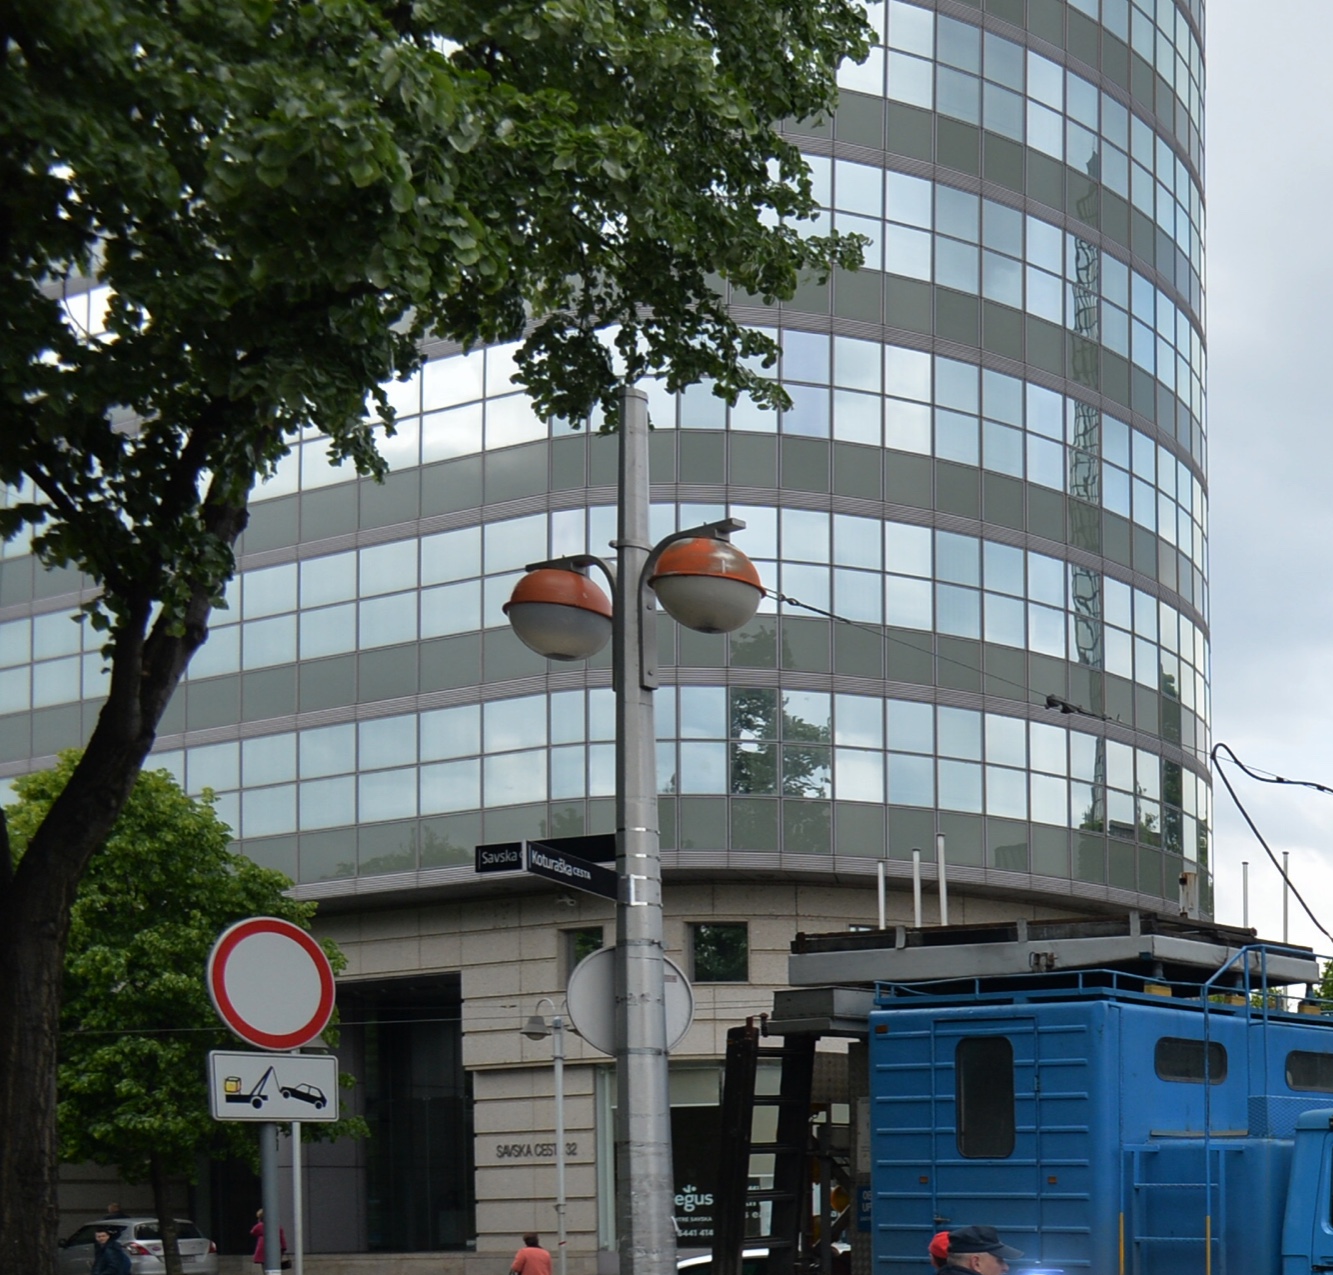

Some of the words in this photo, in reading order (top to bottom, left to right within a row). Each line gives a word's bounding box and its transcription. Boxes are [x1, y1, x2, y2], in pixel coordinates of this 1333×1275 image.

[482, 849, 518, 864] Savska
[531, 849, 573, 877] Koturaška
[572, 866, 592, 880] CESTA
[496, 1143, 533, 1158] SAVSKA
[534, 1143, 557, 1157] CEST
[565, 1142, 578, 1156] 32
[674, 1193, 714, 1213] egus
